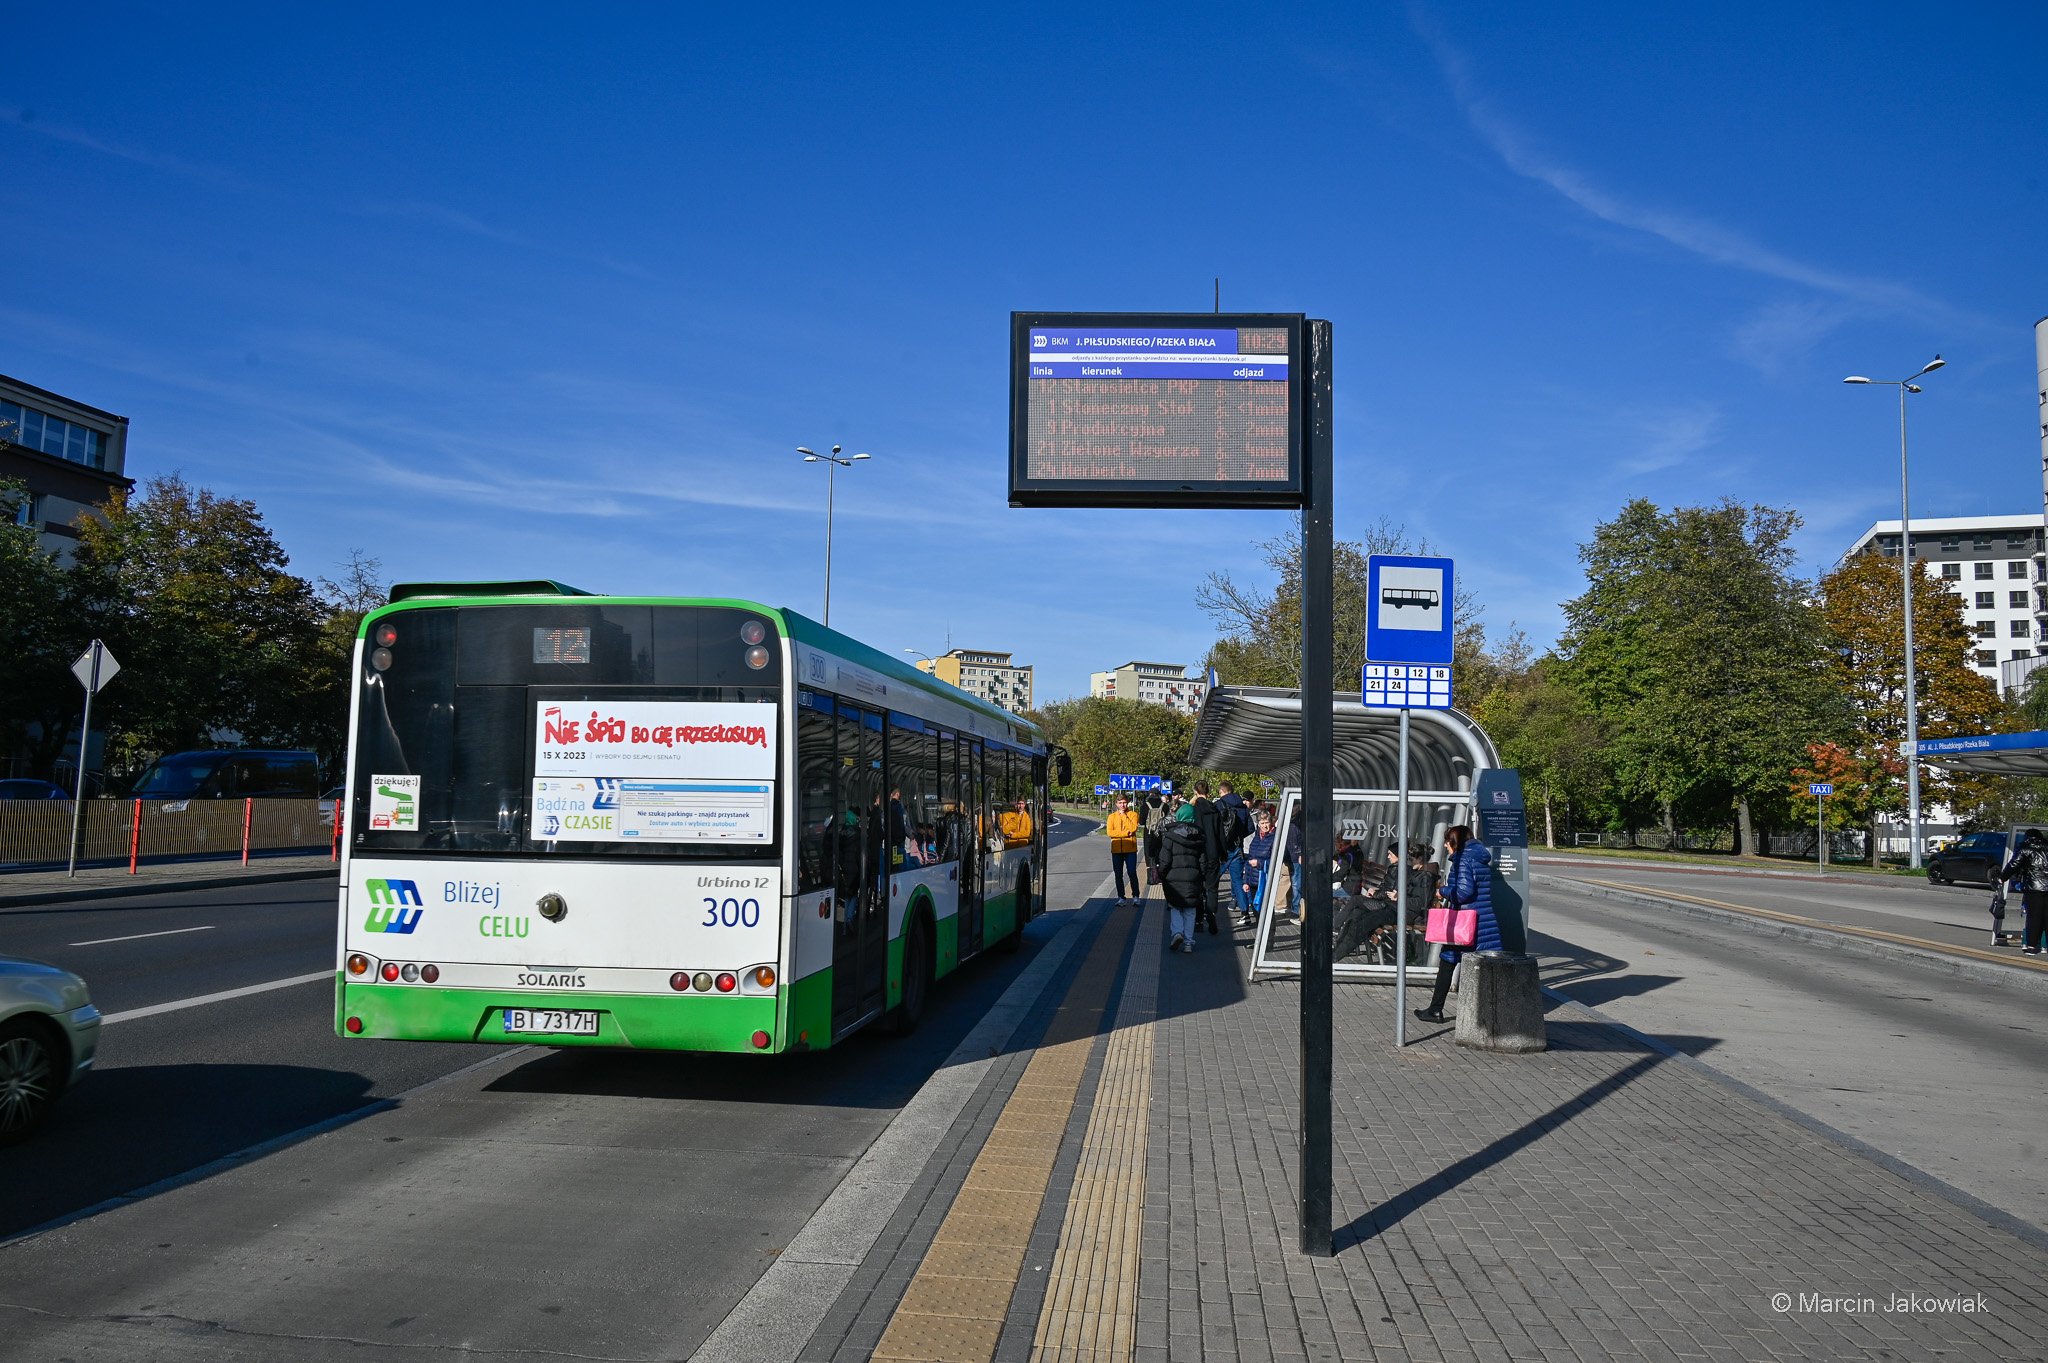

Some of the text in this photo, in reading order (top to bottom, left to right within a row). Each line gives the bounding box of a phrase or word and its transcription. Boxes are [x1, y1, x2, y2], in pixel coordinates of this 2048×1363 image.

[1051, 337, 1069, 346] BKM
[1188, 338, 1216, 347] BIAŁA
[1243, 333, 1286, 349] 10:29
[1033, 366, 1264, 378] linia kierunek odjazd
[1168, 379, 1200, 394] PKP
[1048, 421, 1056, 435] 9
[1062, 420, 1165, 437] Produkcyjna
[1061, 462, 1136, 477] Herberta
[547, 630, 583, 661] 12
[1374, 667, 1444, 678] 1 9 12 18
[1370, 681, 1401, 690] 21 24
[631, 726, 649, 743] BO
[543, 751, 552, 759] 15
[554, 751, 561, 760] X
[563, 751, 586, 760] 2023
[1811, 785, 1831, 794] TAXI
[537, 797, 585, 813] Bądź na
[564, 815, 613, 830] CZASIE
[667, 811, 693, 819] parkingu
[698, 811, 717, 819] znajdź
[688, 820, 711, 828] wybierz
[697, 876, 769, 888] Urbino 12
[444, 880, 500, 909] Bliżej
[702, 897, 760, 928] 300
[479, 915, 529, 938] CELU
[517, 973, 586, 988] SOLARIS
[514, 1012, 534, 1029] BI
[543, 1012, 594, 1031] 7317H
